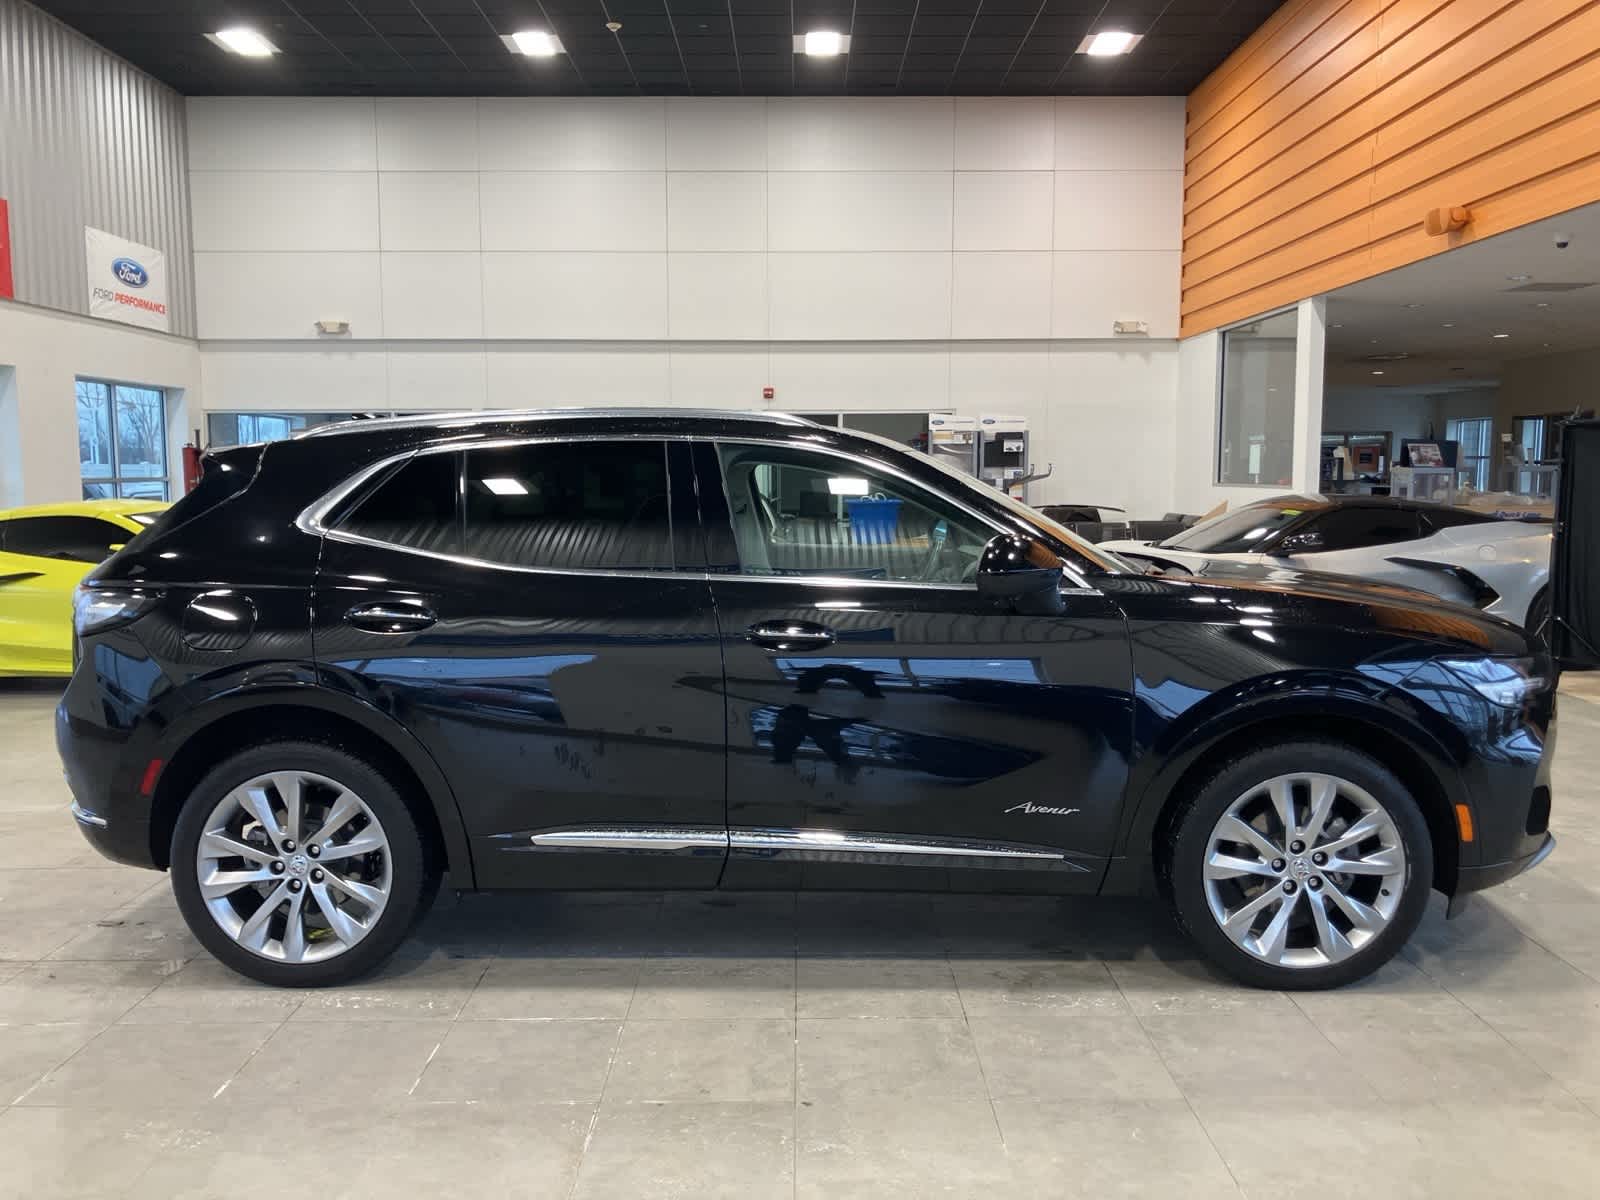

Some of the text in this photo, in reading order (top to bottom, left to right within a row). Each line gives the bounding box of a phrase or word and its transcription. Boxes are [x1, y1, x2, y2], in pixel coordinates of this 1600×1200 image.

[119, 262, 141, 284] Ford
[93, 287, 166, 314] FORD PERFORMANCE
